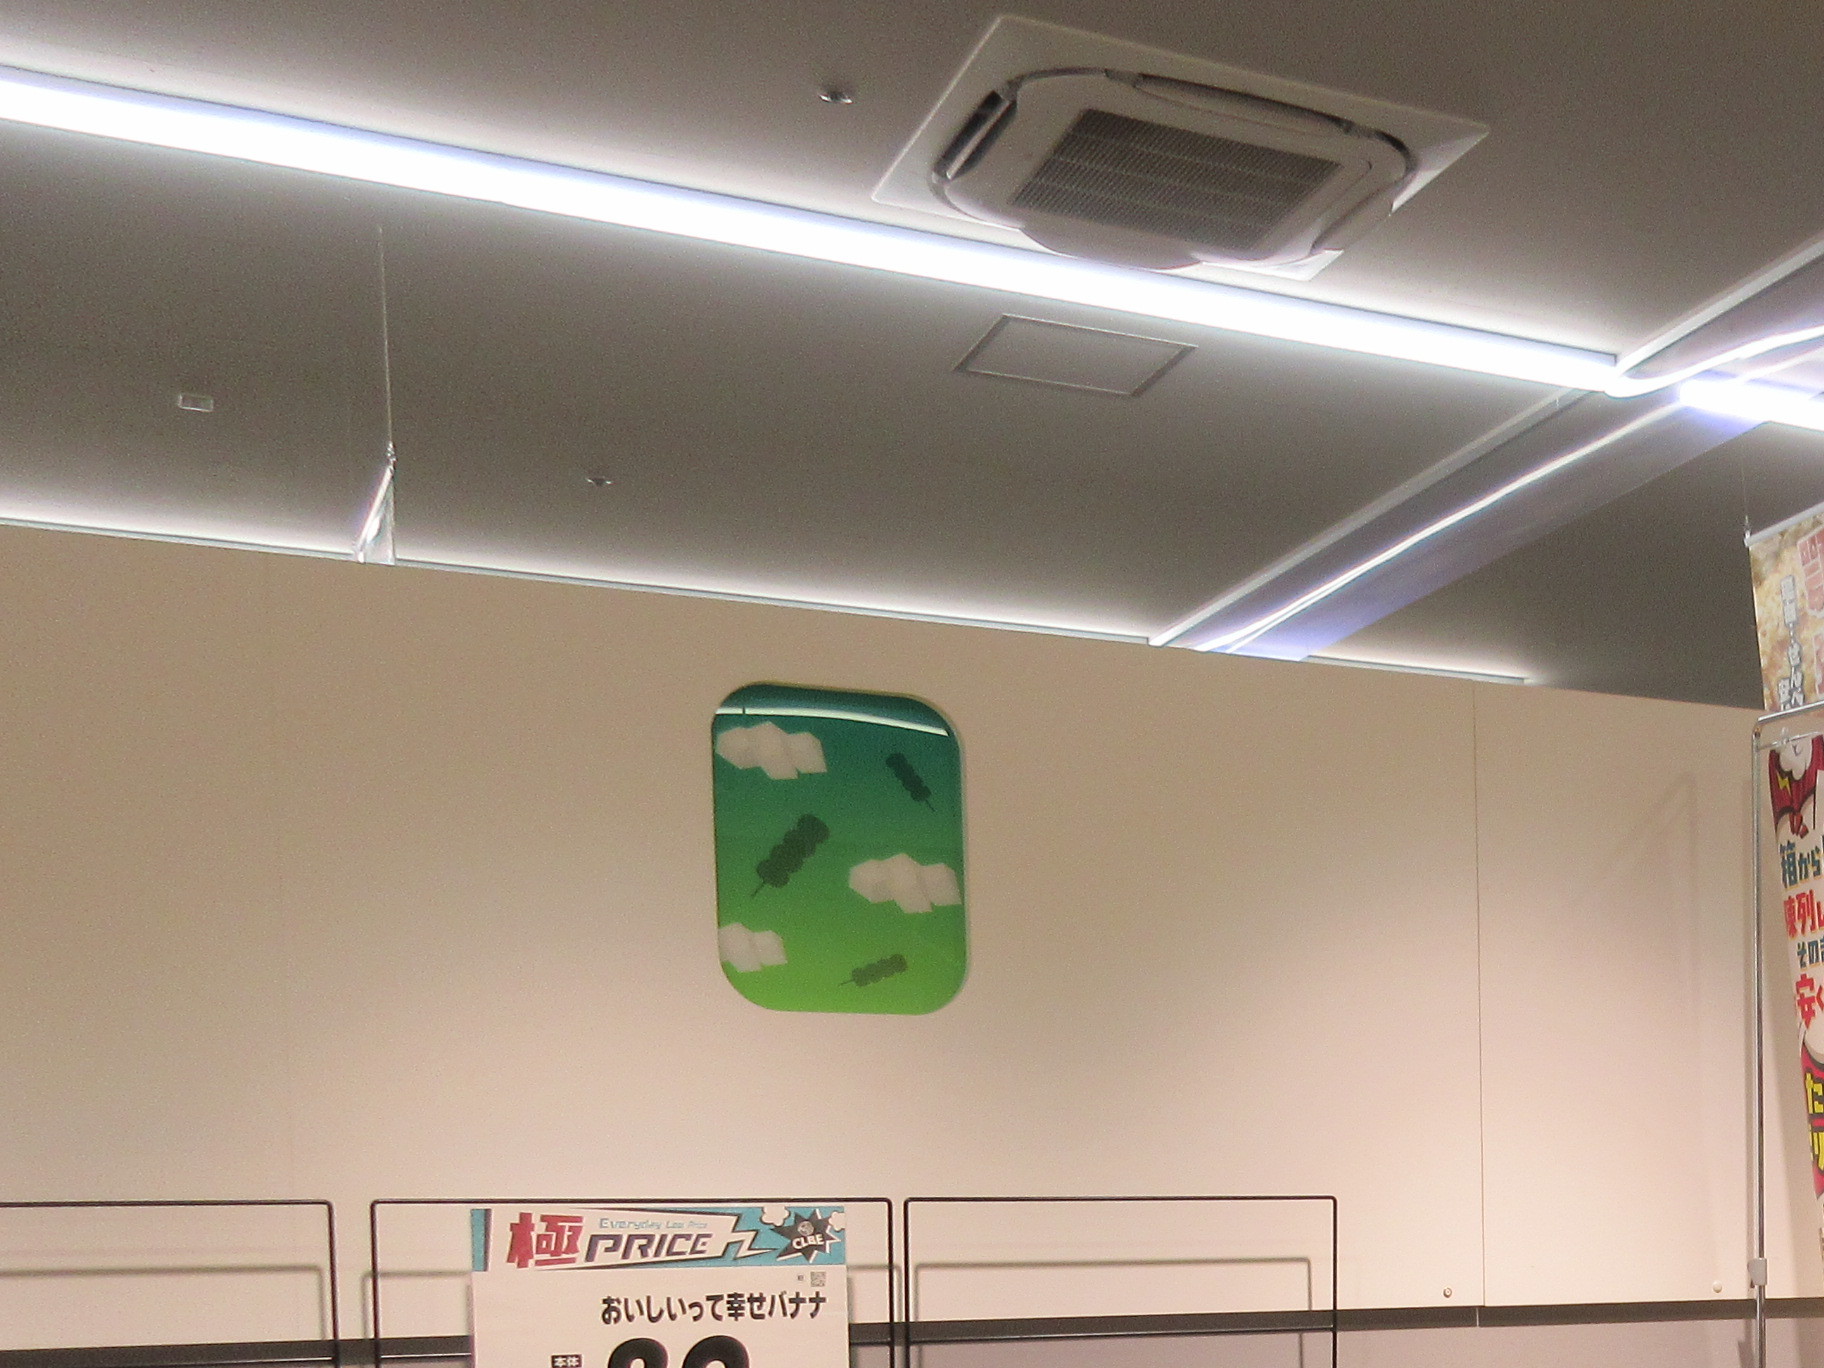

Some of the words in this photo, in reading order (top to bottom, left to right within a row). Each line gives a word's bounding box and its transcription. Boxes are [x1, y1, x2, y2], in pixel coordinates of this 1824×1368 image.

[599, 1217, 661, 1231] Everyday
[507, 1211, 584, 1269] 極
[585, 1233, 713, 1263] PRICE
[792, 1233, 825, 1249] CLBE
[601, 1291, 827, 1326] おいしいって幸せバナナ
[552, 1355, 581, 1368] 本体
